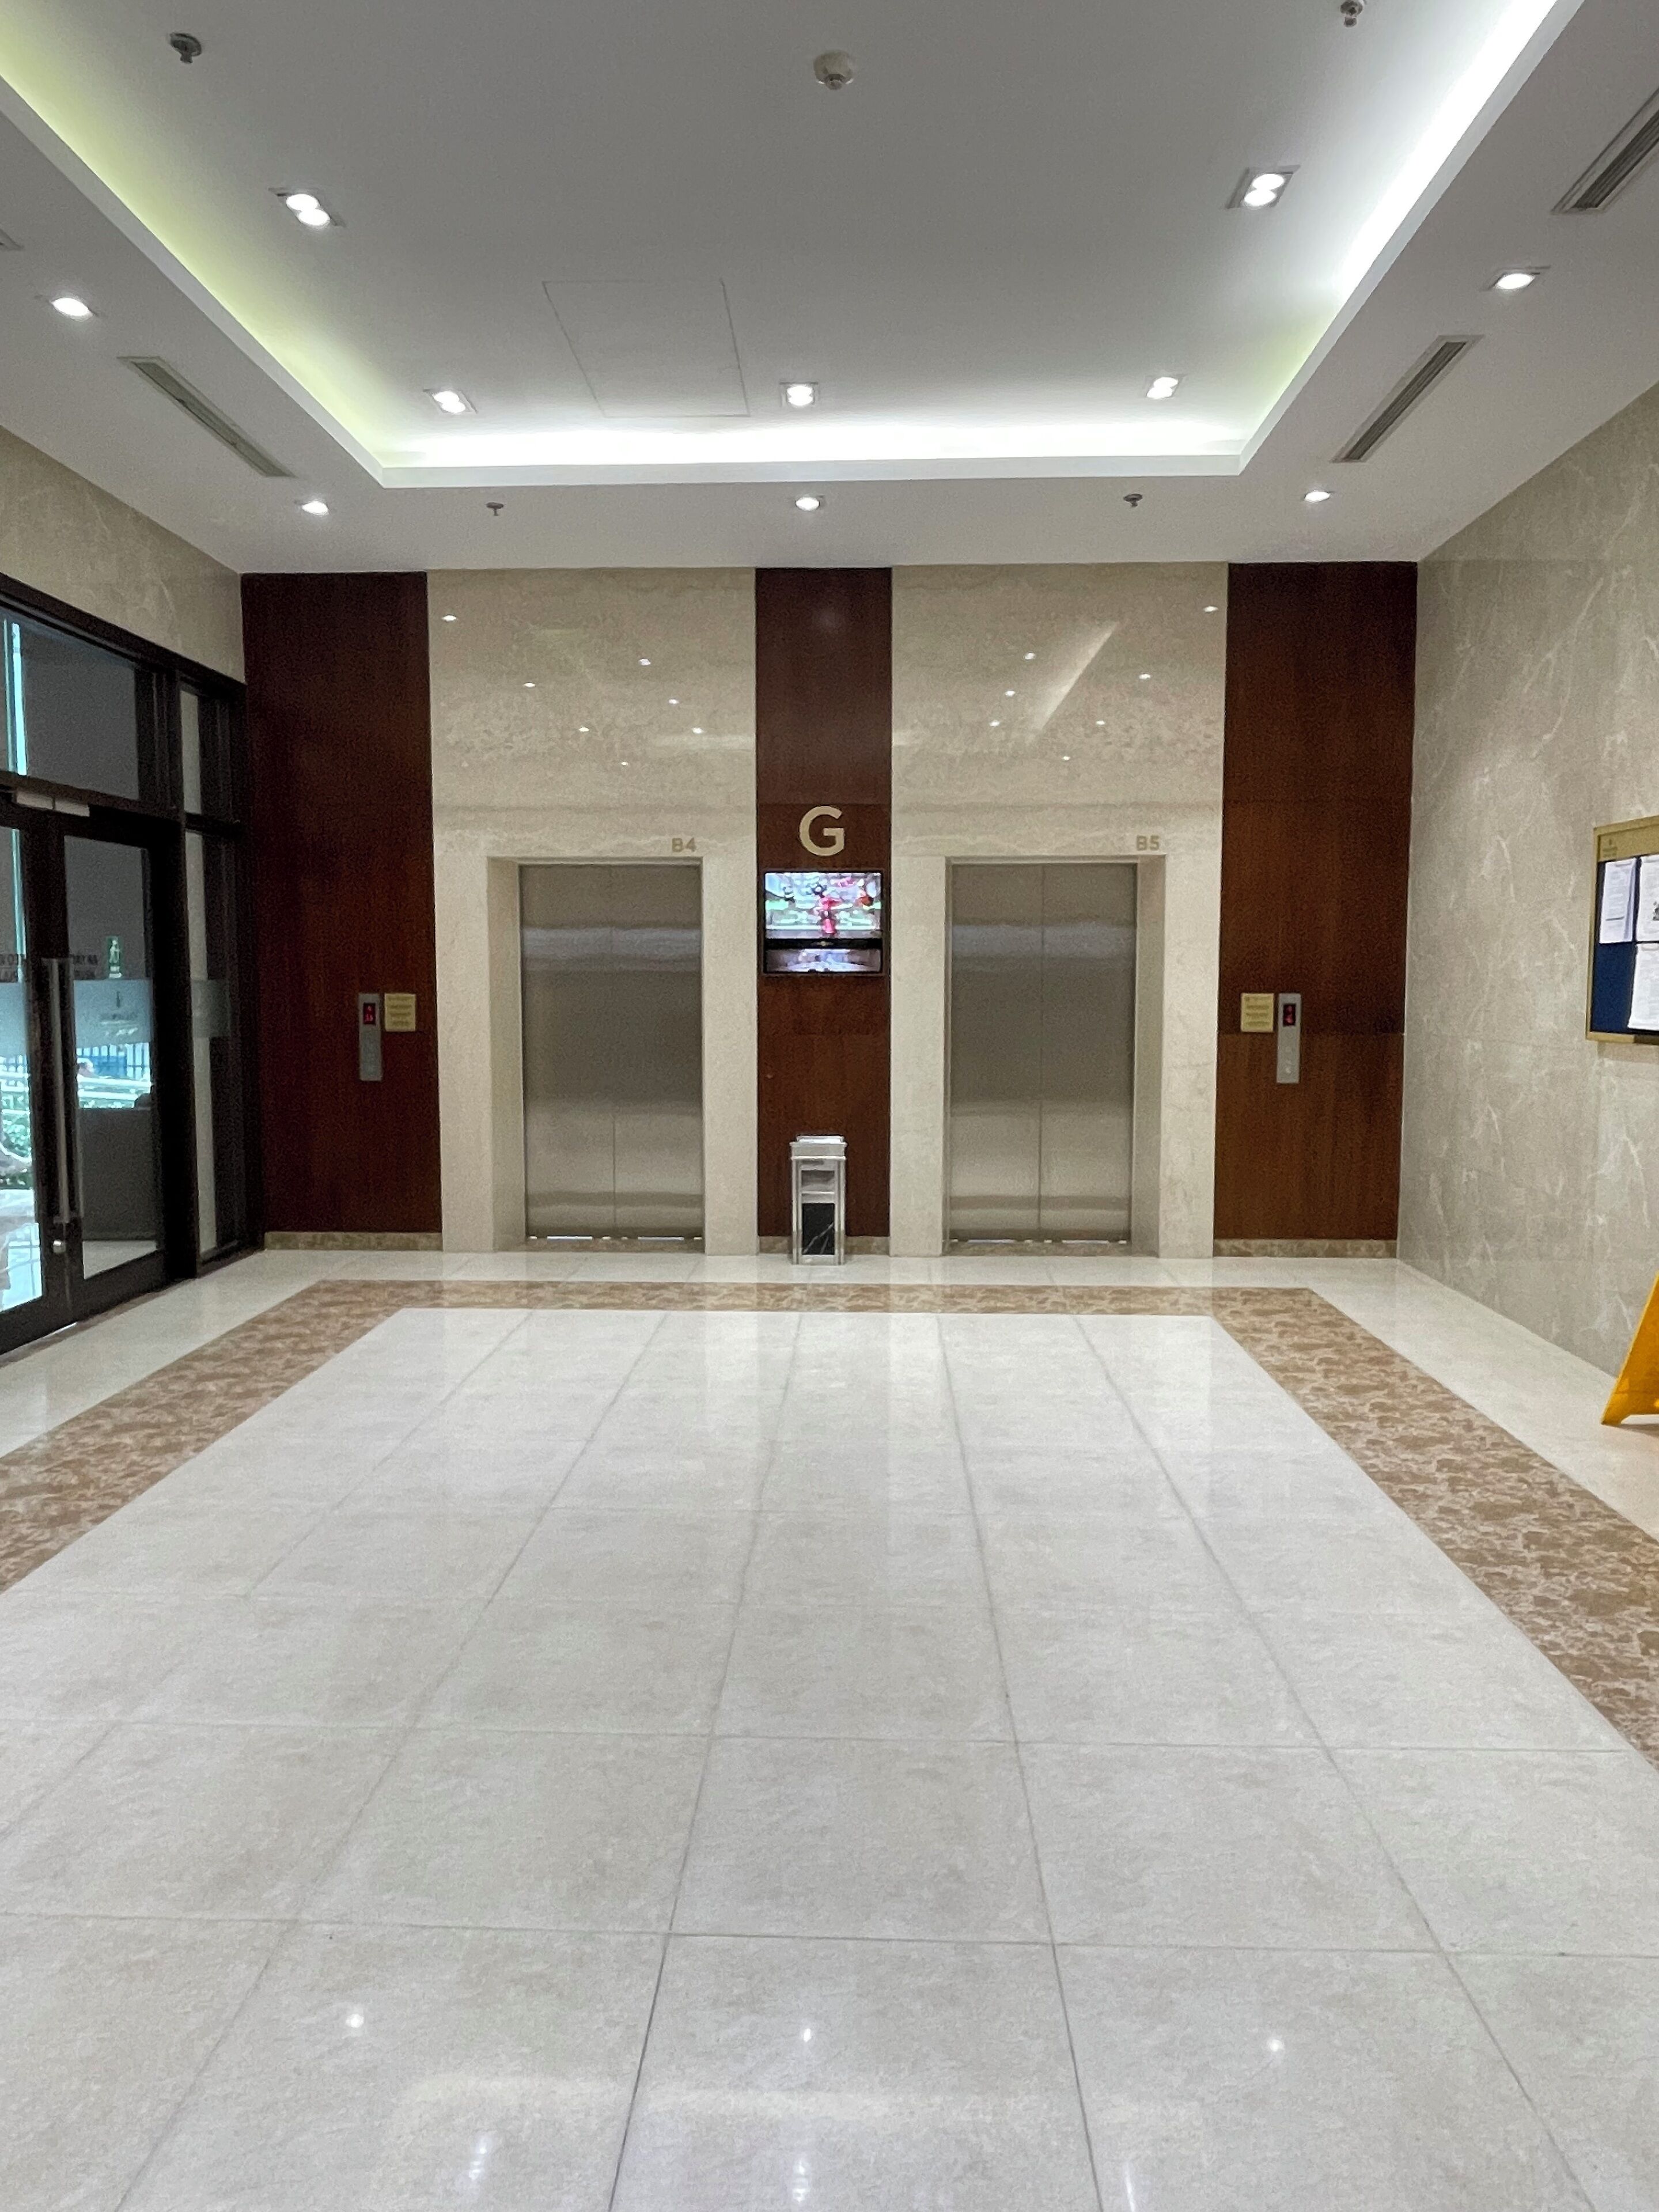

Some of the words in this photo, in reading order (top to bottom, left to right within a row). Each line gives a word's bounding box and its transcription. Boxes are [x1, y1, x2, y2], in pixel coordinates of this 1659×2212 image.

[799, 806, 846, 856] G
[672, 838, 696, 852] B4
[1137, 835, 1160, 851] B5
